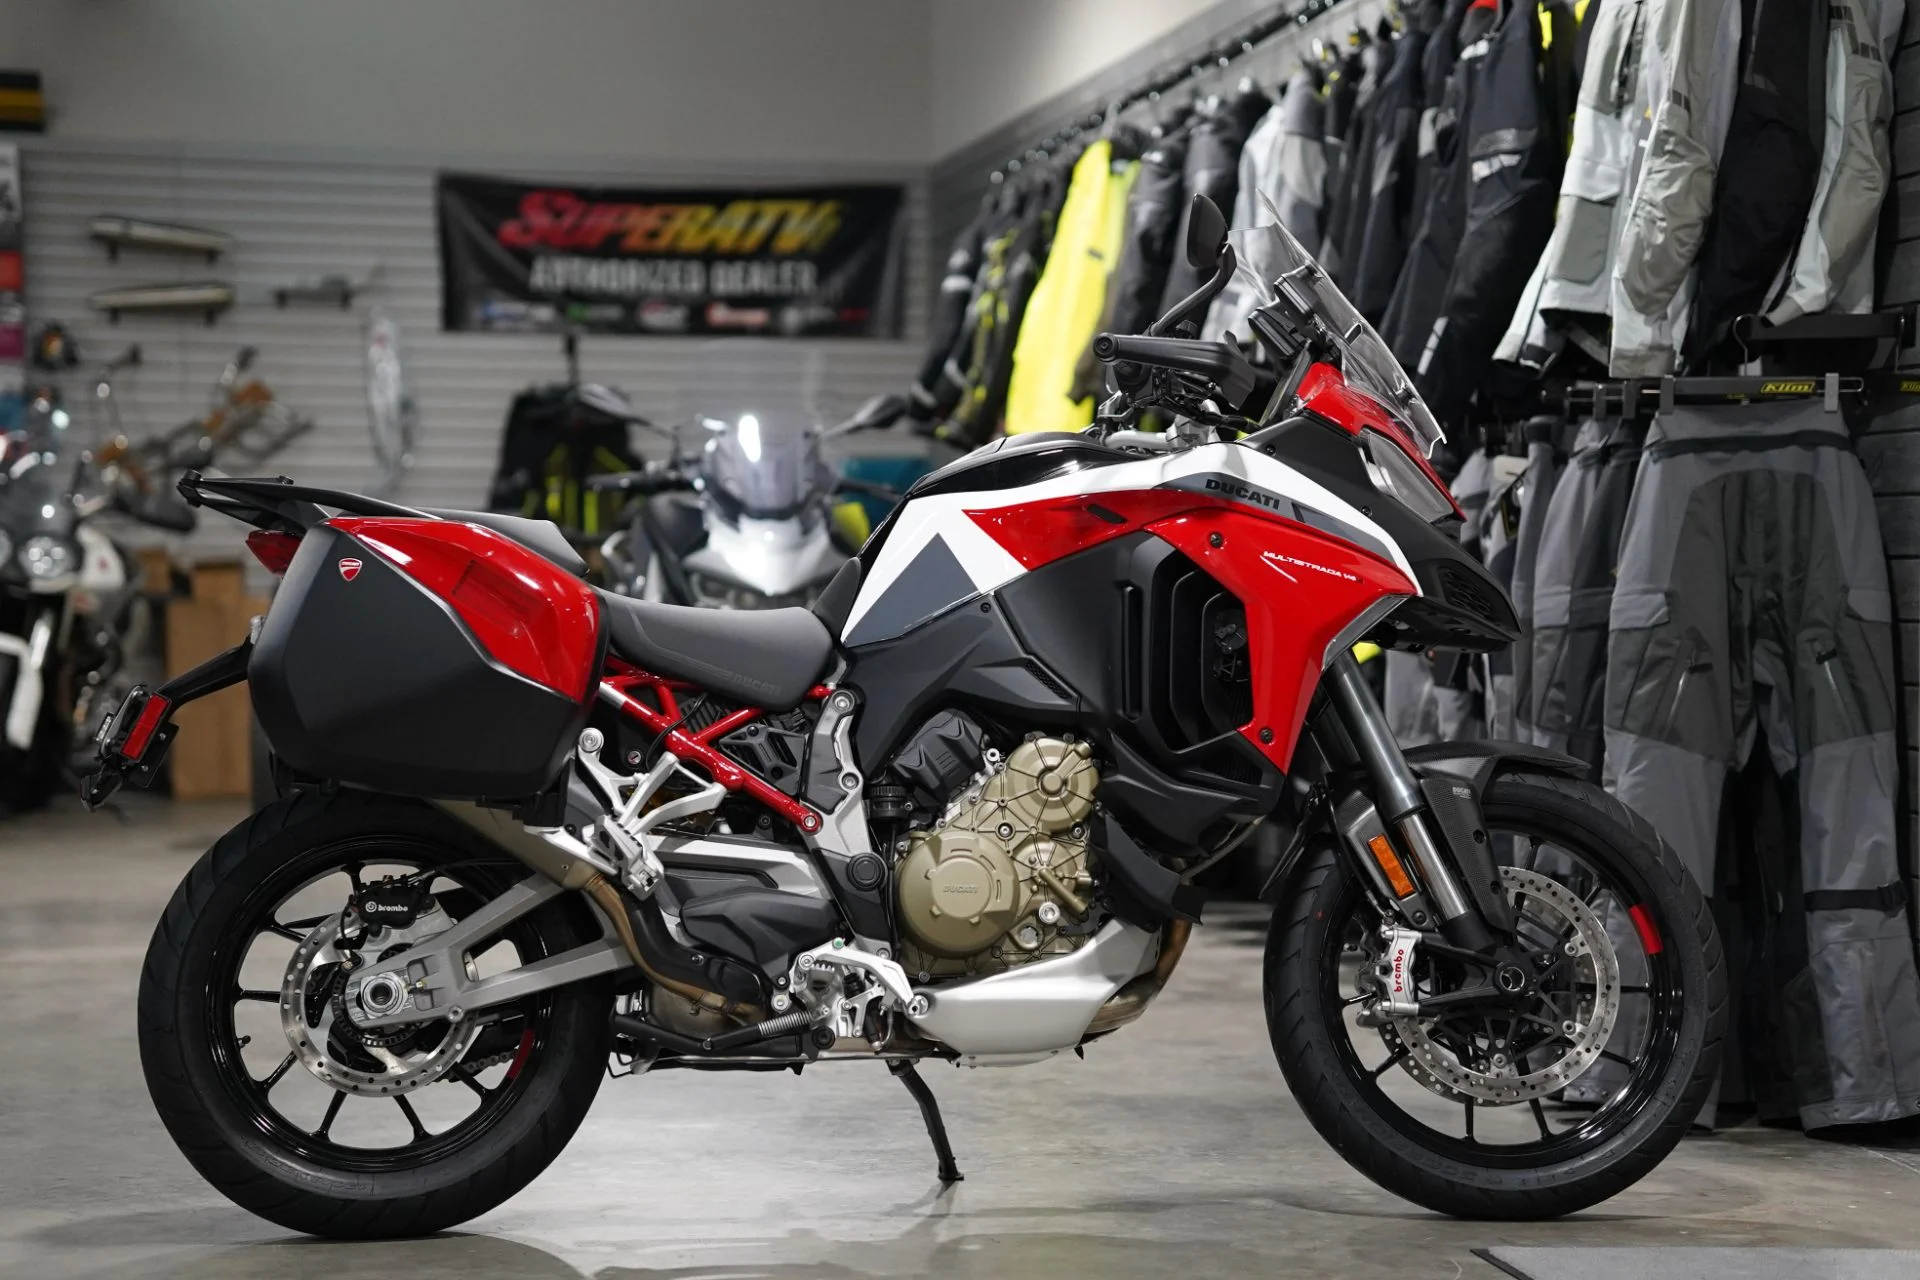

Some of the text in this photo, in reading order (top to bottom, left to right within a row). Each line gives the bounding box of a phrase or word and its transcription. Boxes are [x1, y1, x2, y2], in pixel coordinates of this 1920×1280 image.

[529, 255, 818, 298] AUTHORIZED DEALER
[1763, 382, 1811, 393] Klim
[1205, 478, 1281, 510] DUCATI
[1263, 551, 1342, 578] MULTISTRADA
[378, 904, 408, 912] brembo
[1393, 949, 1405, 993] brembo
